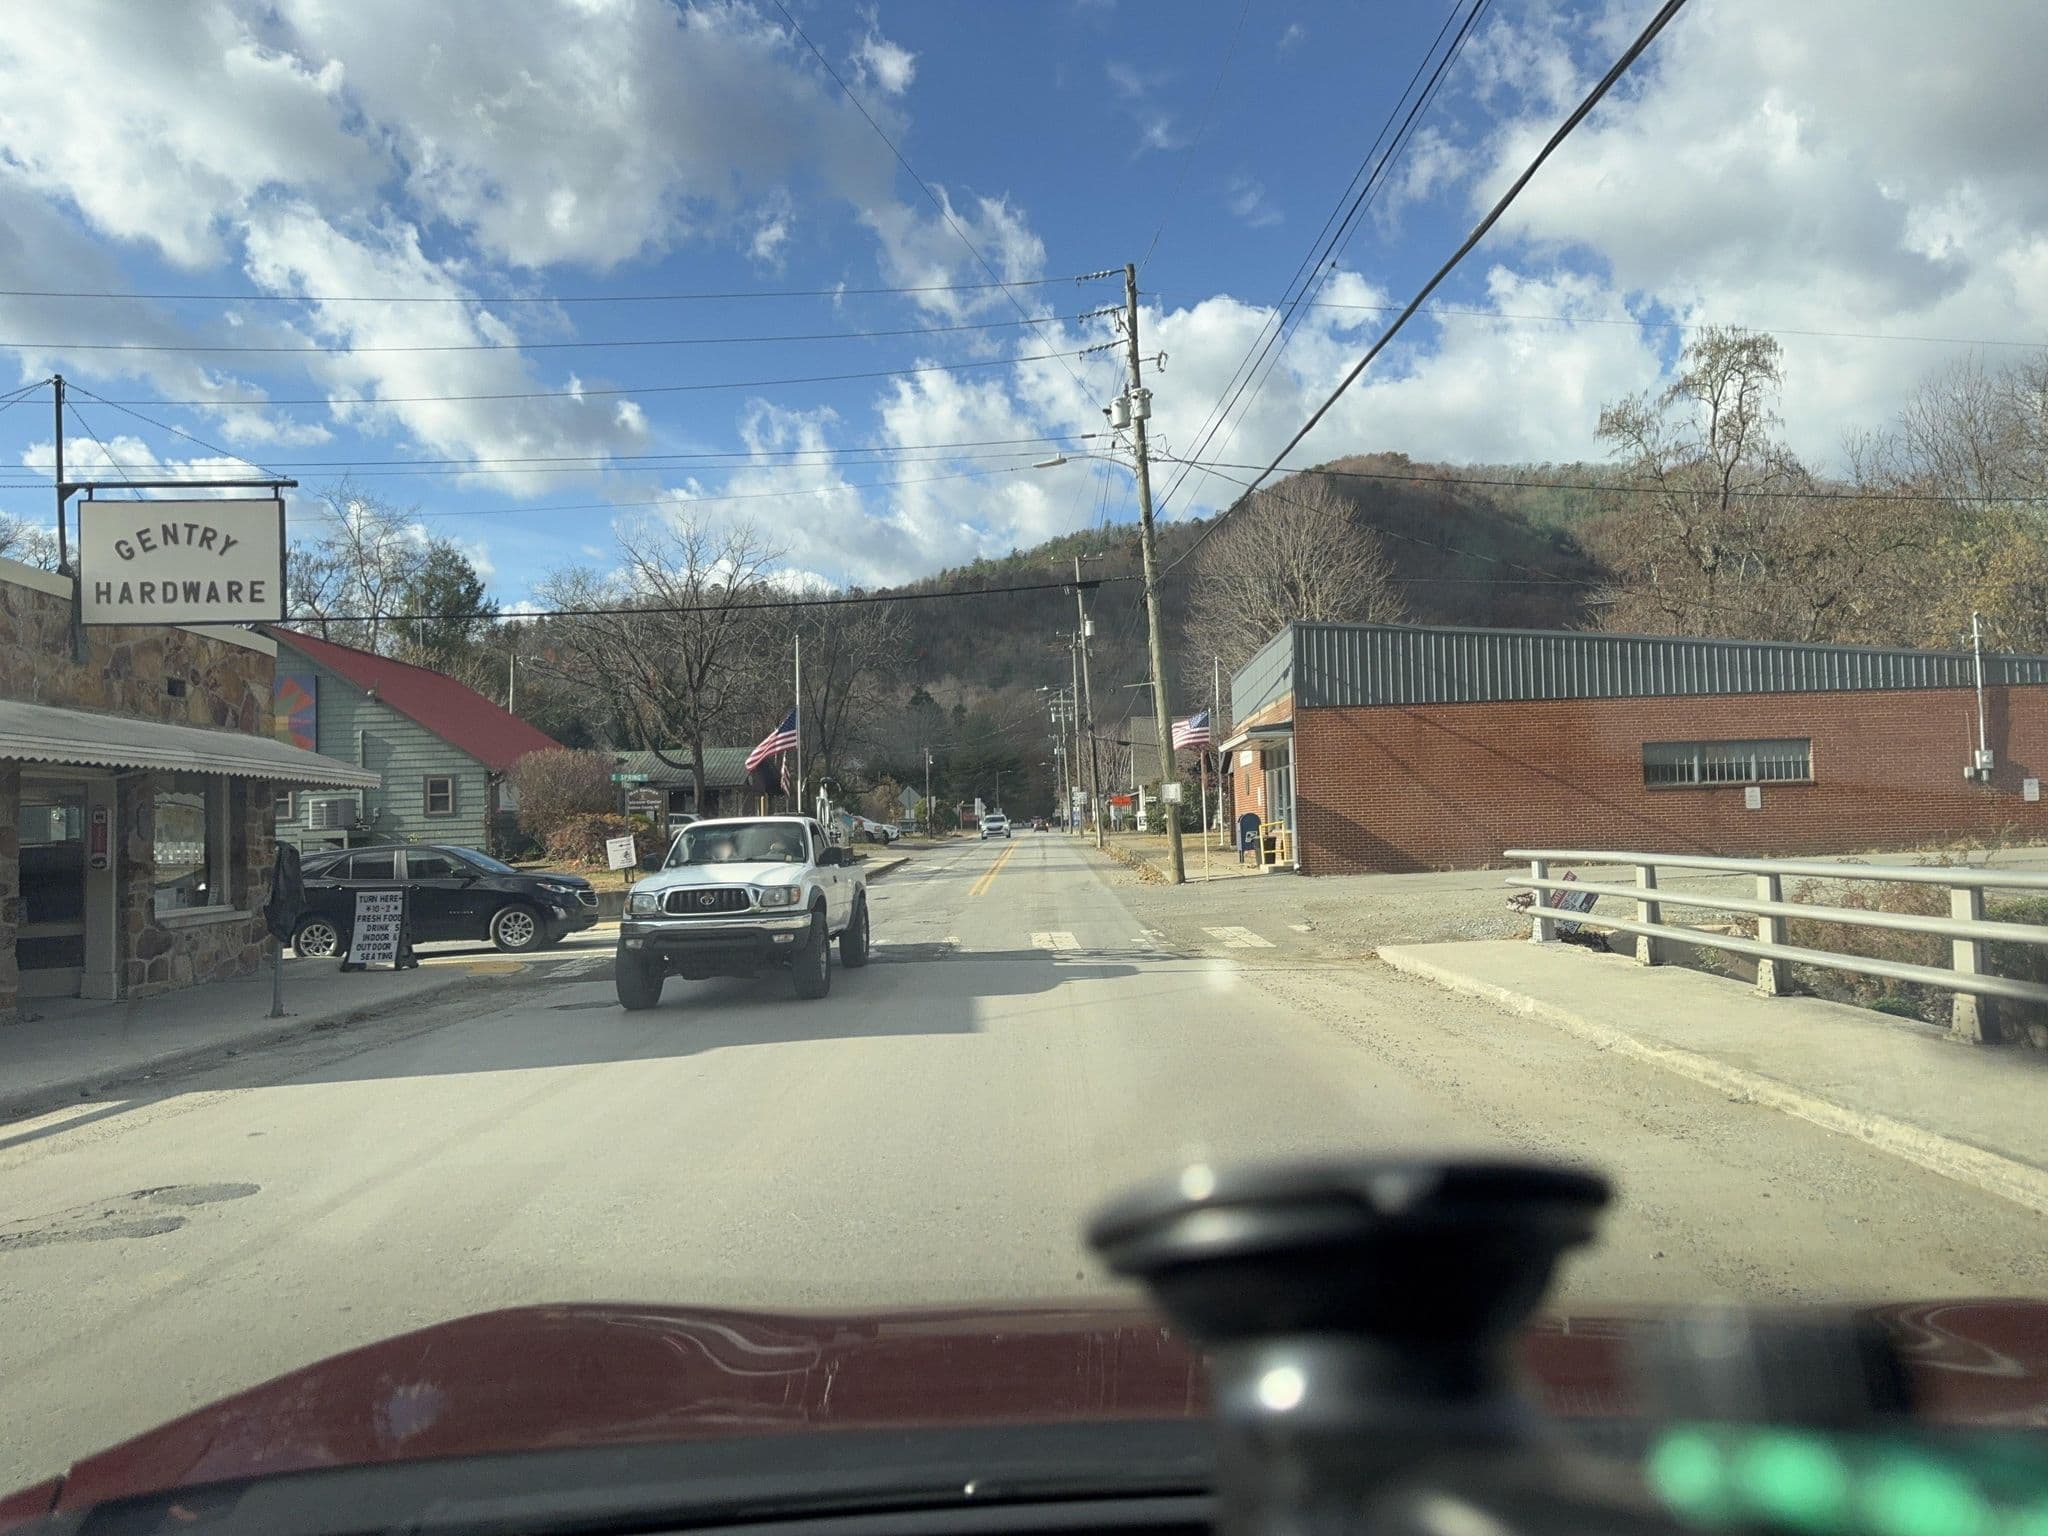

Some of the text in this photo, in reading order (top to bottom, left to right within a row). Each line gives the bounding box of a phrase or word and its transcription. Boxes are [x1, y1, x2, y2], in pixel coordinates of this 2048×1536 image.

[115, 522, 239, 561] GENTRY
[95, 580, 265, 604] HARDWARE
[359, 895, 378, 903] TURN
[357, 914, 381, 922] FRESH
[363, 933, 389, 941] INDOOR
[356, 943, 391, 951] OUTDOOR
[360, 952, 392, 960] SEATING
